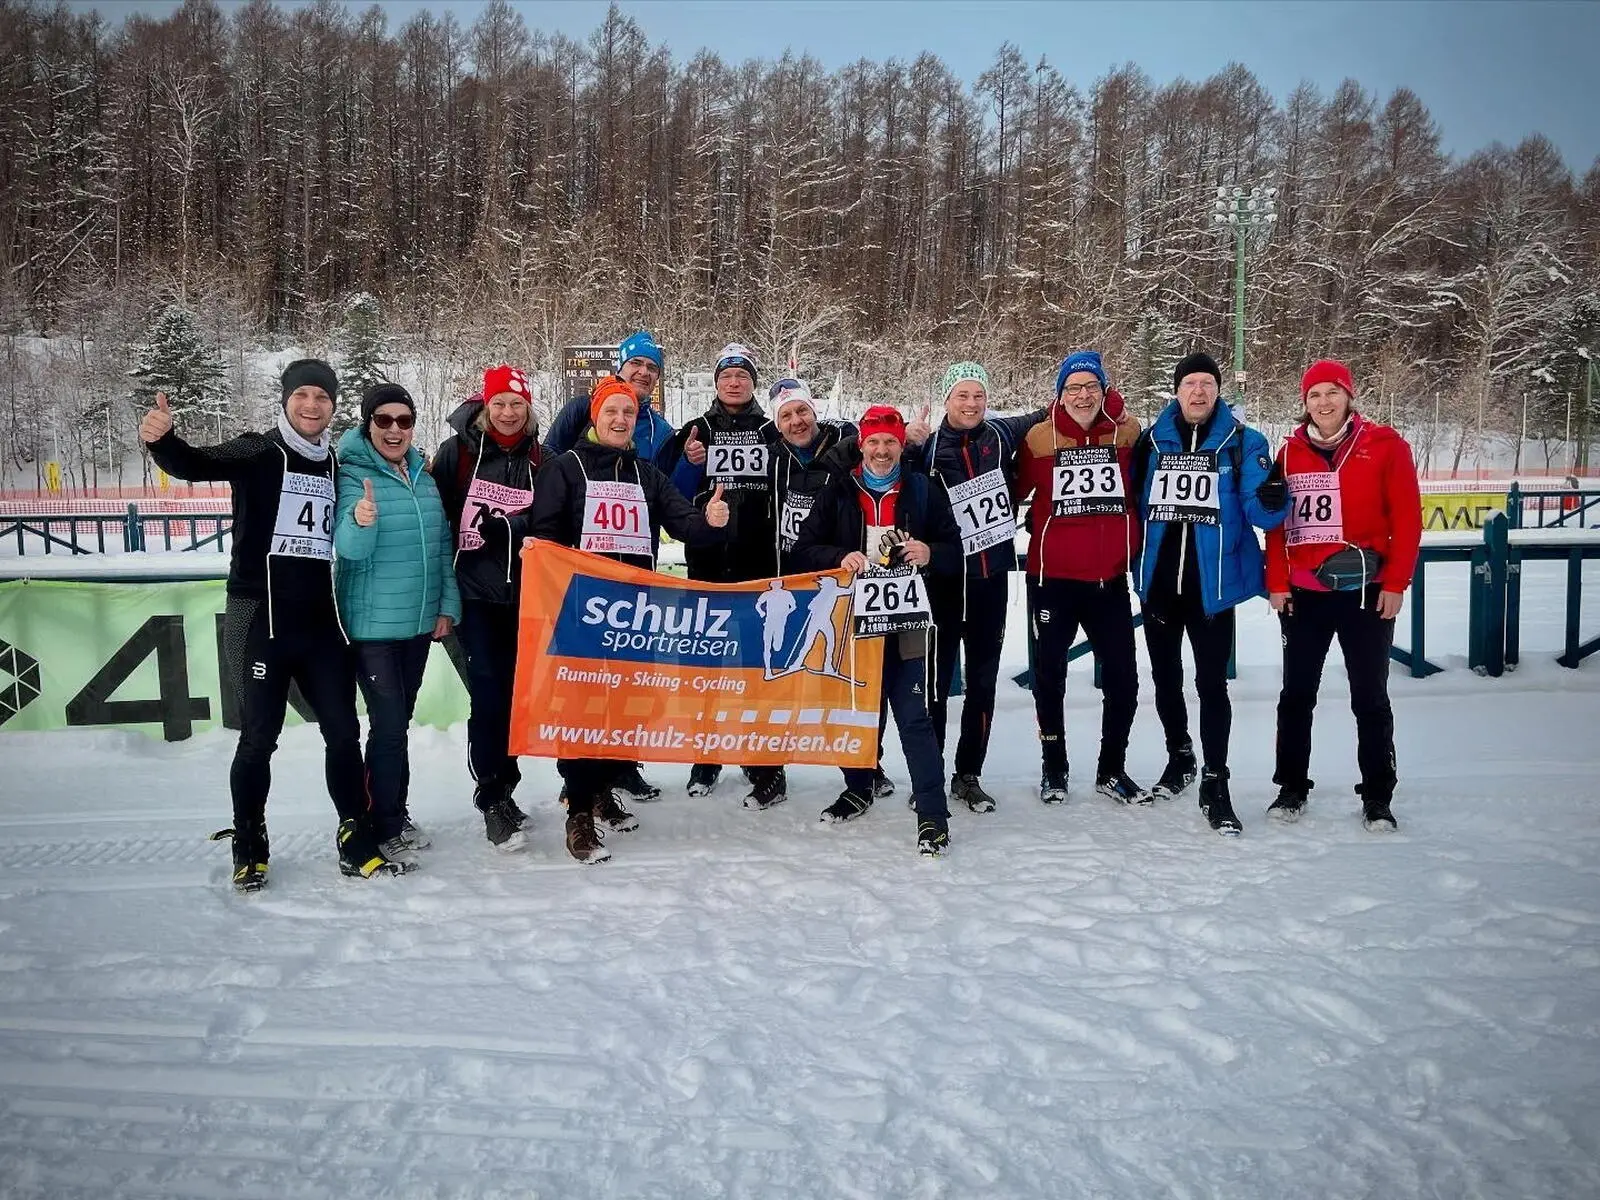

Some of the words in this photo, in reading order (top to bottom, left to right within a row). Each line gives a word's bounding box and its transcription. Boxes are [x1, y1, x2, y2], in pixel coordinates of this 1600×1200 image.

[715, 447, 763, 472] 263
[1060, 453, 1111, 462] INTERNATIONAL
[1072, 458, 1109, 466] MARATHON
[1059, 466, 1116, 496] 233
[1159, 472, 1211, 502] 190
[297, 500, 332, 535] 48
[593, 501, 639, 533] 401
[962, 491, 1011, 529] 129
[863, 571, 875, 579] SKI
[875, 569, 911, 578] MARATHON
[863, 580, 919, 612] 264
[582, 591, 731, 637] schulz
[601, 629, 739, 657] sportreisen
[556, 665, 622, 689] Running
[631, 670, 681, 692] Skiing
[692, 675, 747, 695] Cycling
[538, 722, 862, 755] www.schulz-sportreisen.de
